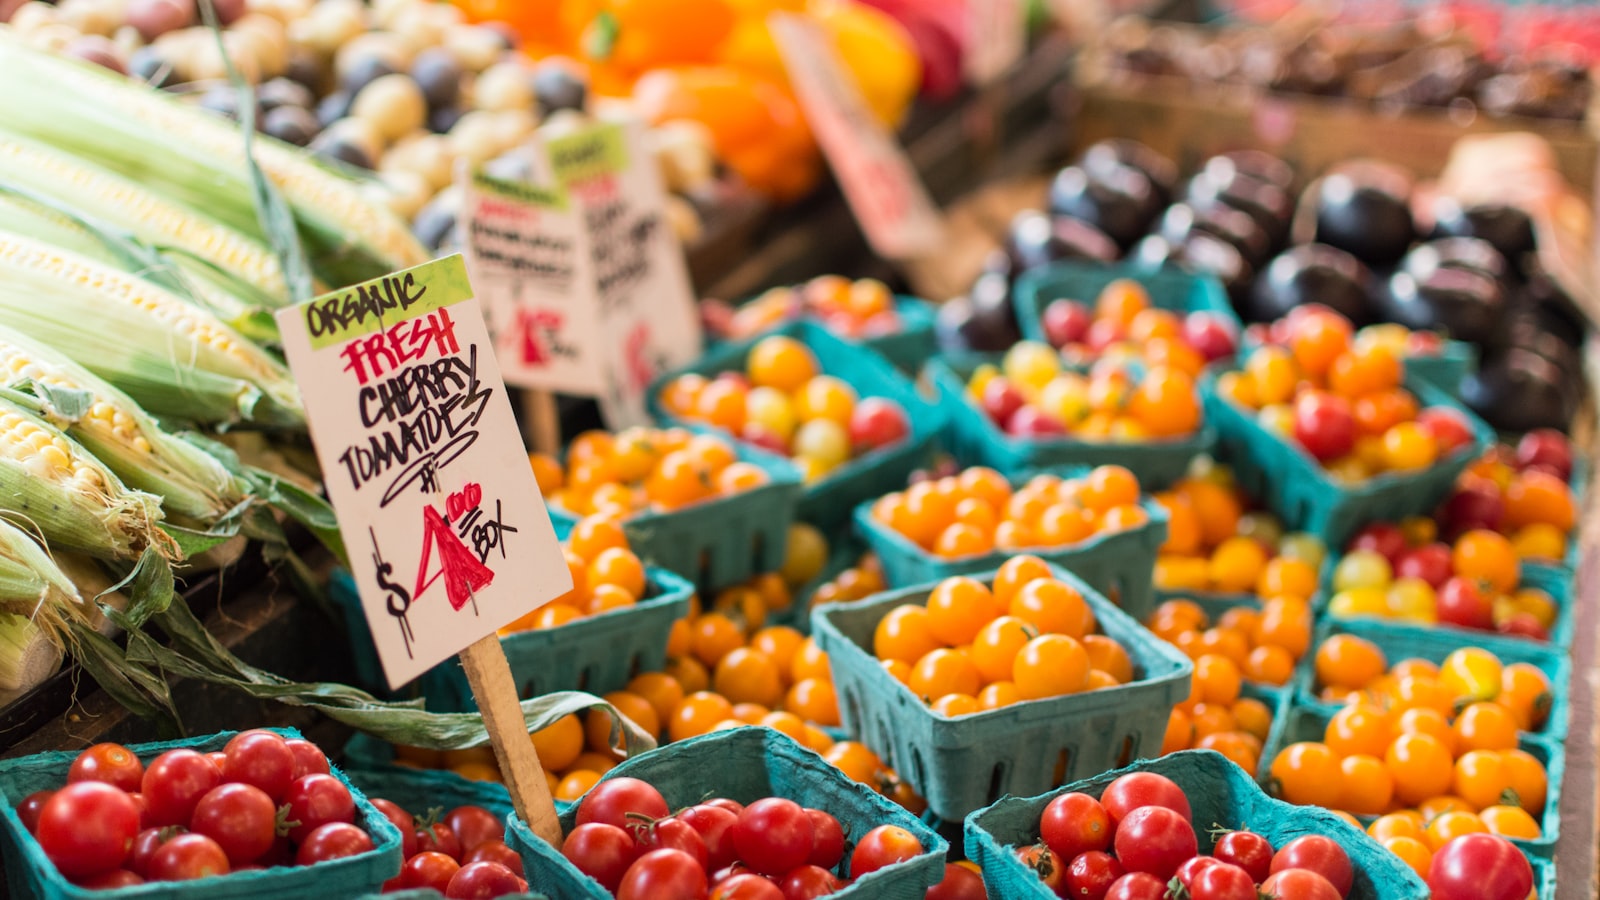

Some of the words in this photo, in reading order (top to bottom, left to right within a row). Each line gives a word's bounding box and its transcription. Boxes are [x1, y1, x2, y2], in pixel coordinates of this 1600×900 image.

[306, 272, 427, 338] ORGANIC
[339, 306, 461, 386] FRESH
[358, 343, 478, 429] CHERRY
[337, 379, 494, 491] TOMATOES
[471, 498, 518, 566] BOX
